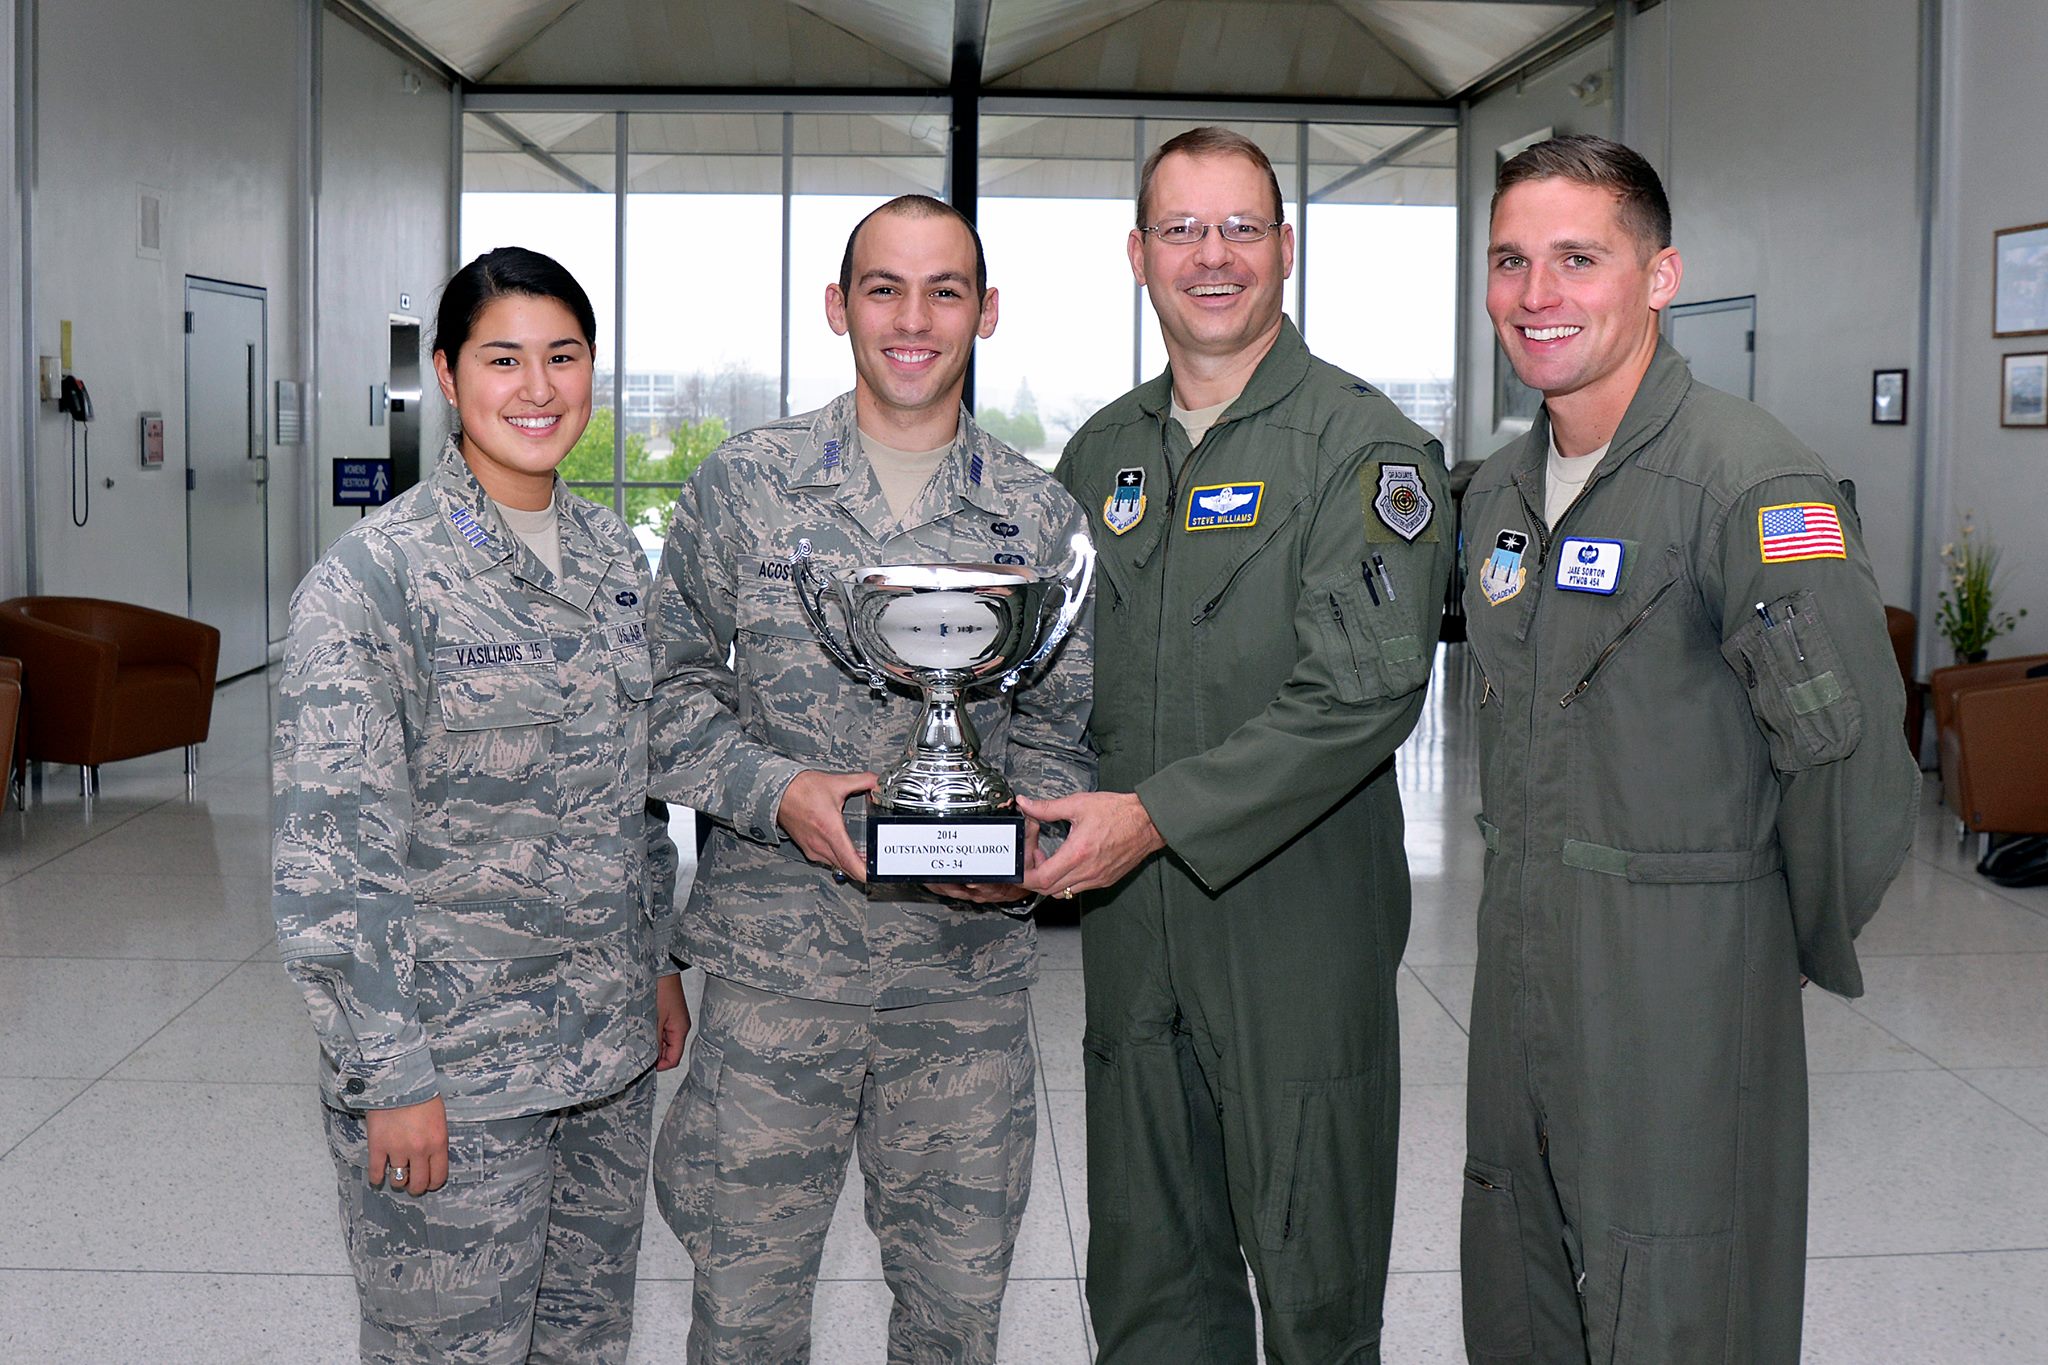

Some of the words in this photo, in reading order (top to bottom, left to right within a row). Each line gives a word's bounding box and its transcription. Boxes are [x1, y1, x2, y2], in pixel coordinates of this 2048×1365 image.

[1388, 471, 1413, 479] GRADUATE
[342, 478, 370, 488] RESTROOM
[1192, 516, 1215, 526] STEVE
[1217, 513, 1252, 524] WILLIAMS
[758, 561, 807, 583] ACOSA
[1567, 566, 1581, 575] JAKE
[1582, 567, 1606, 578] SORTOR
[1490, 584, 1518, 602] ACADEMY
[456, 644, 523, 666] VASILIADIS
[530, 643, 543, 660] 15
[937, 830, 957, 840] 2014
[884, 845, 954, 855] OUTSTANDING
[955, 845, 1010, 856] SQUADRON
[931, 859, 944, 869] CS
[952, 859, 963, 869] 34
